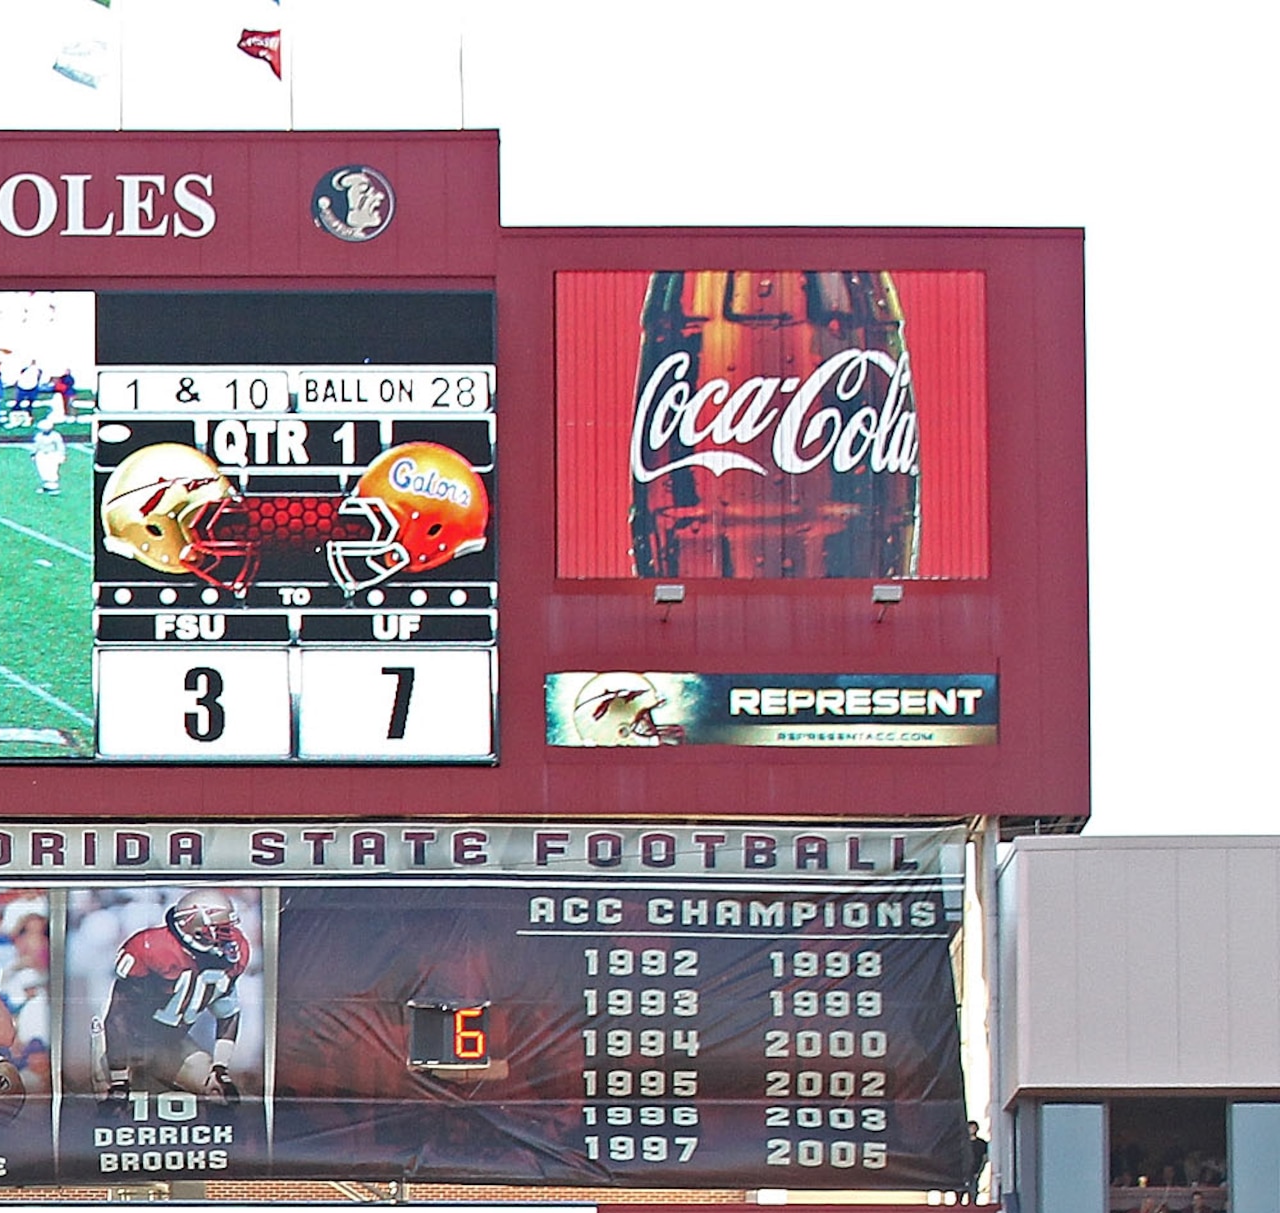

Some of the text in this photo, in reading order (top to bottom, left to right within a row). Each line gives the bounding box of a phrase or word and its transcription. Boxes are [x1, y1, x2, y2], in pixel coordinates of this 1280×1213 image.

[127, 376, 477, 411] 1 & 10 BALL ON 28
[630, 347, 921, 484] Coca-Cola
[213, 419, 356, 468] QTR 1
[388, 457, 472, 508] Gators
[278, 587, 312, 606] TO
[154, 614, 226, 641] FSU
[373, 615, 422, 641] UF
[184, 666, 226, 742] 3
[381, 667, 416, 740] 7
[729, 687, 984, 717] REPRESENT
[776, 731, 935, 743] REPRESENTACC.COM
[248, 829, 490, 868] STATE
[533, 830, 920, 872] FOOTBALL
[529, 896, 938, 930] ACC CHAMPIONS
[583, 948, 699, 978] 1992
[769, 950, 883, 979] 1998
[583, 988, 699, 1018] 1993
[769, 990, 883, 1018] 1999
[453, 1008, 486, 1060] 6
[583, 1028, 700, 1058] 1994
[764, 1030, 888, 1059] 2000
[583, 1069, 699, 1098] 1995
[765, 1070, 887, 1098] 2002
[127, 1091, 197, 1123] 10
[583, 1106, 700, 1127] 1996
[765, 1107, 888, 1132] 2003
[93, 1124, 233, 1148] DERRICK
[583, 1135, 699, 1163] 1997
[99, 1151, 229, 1173] BROOKS
[766, 1138, 888, 1170] 2005
